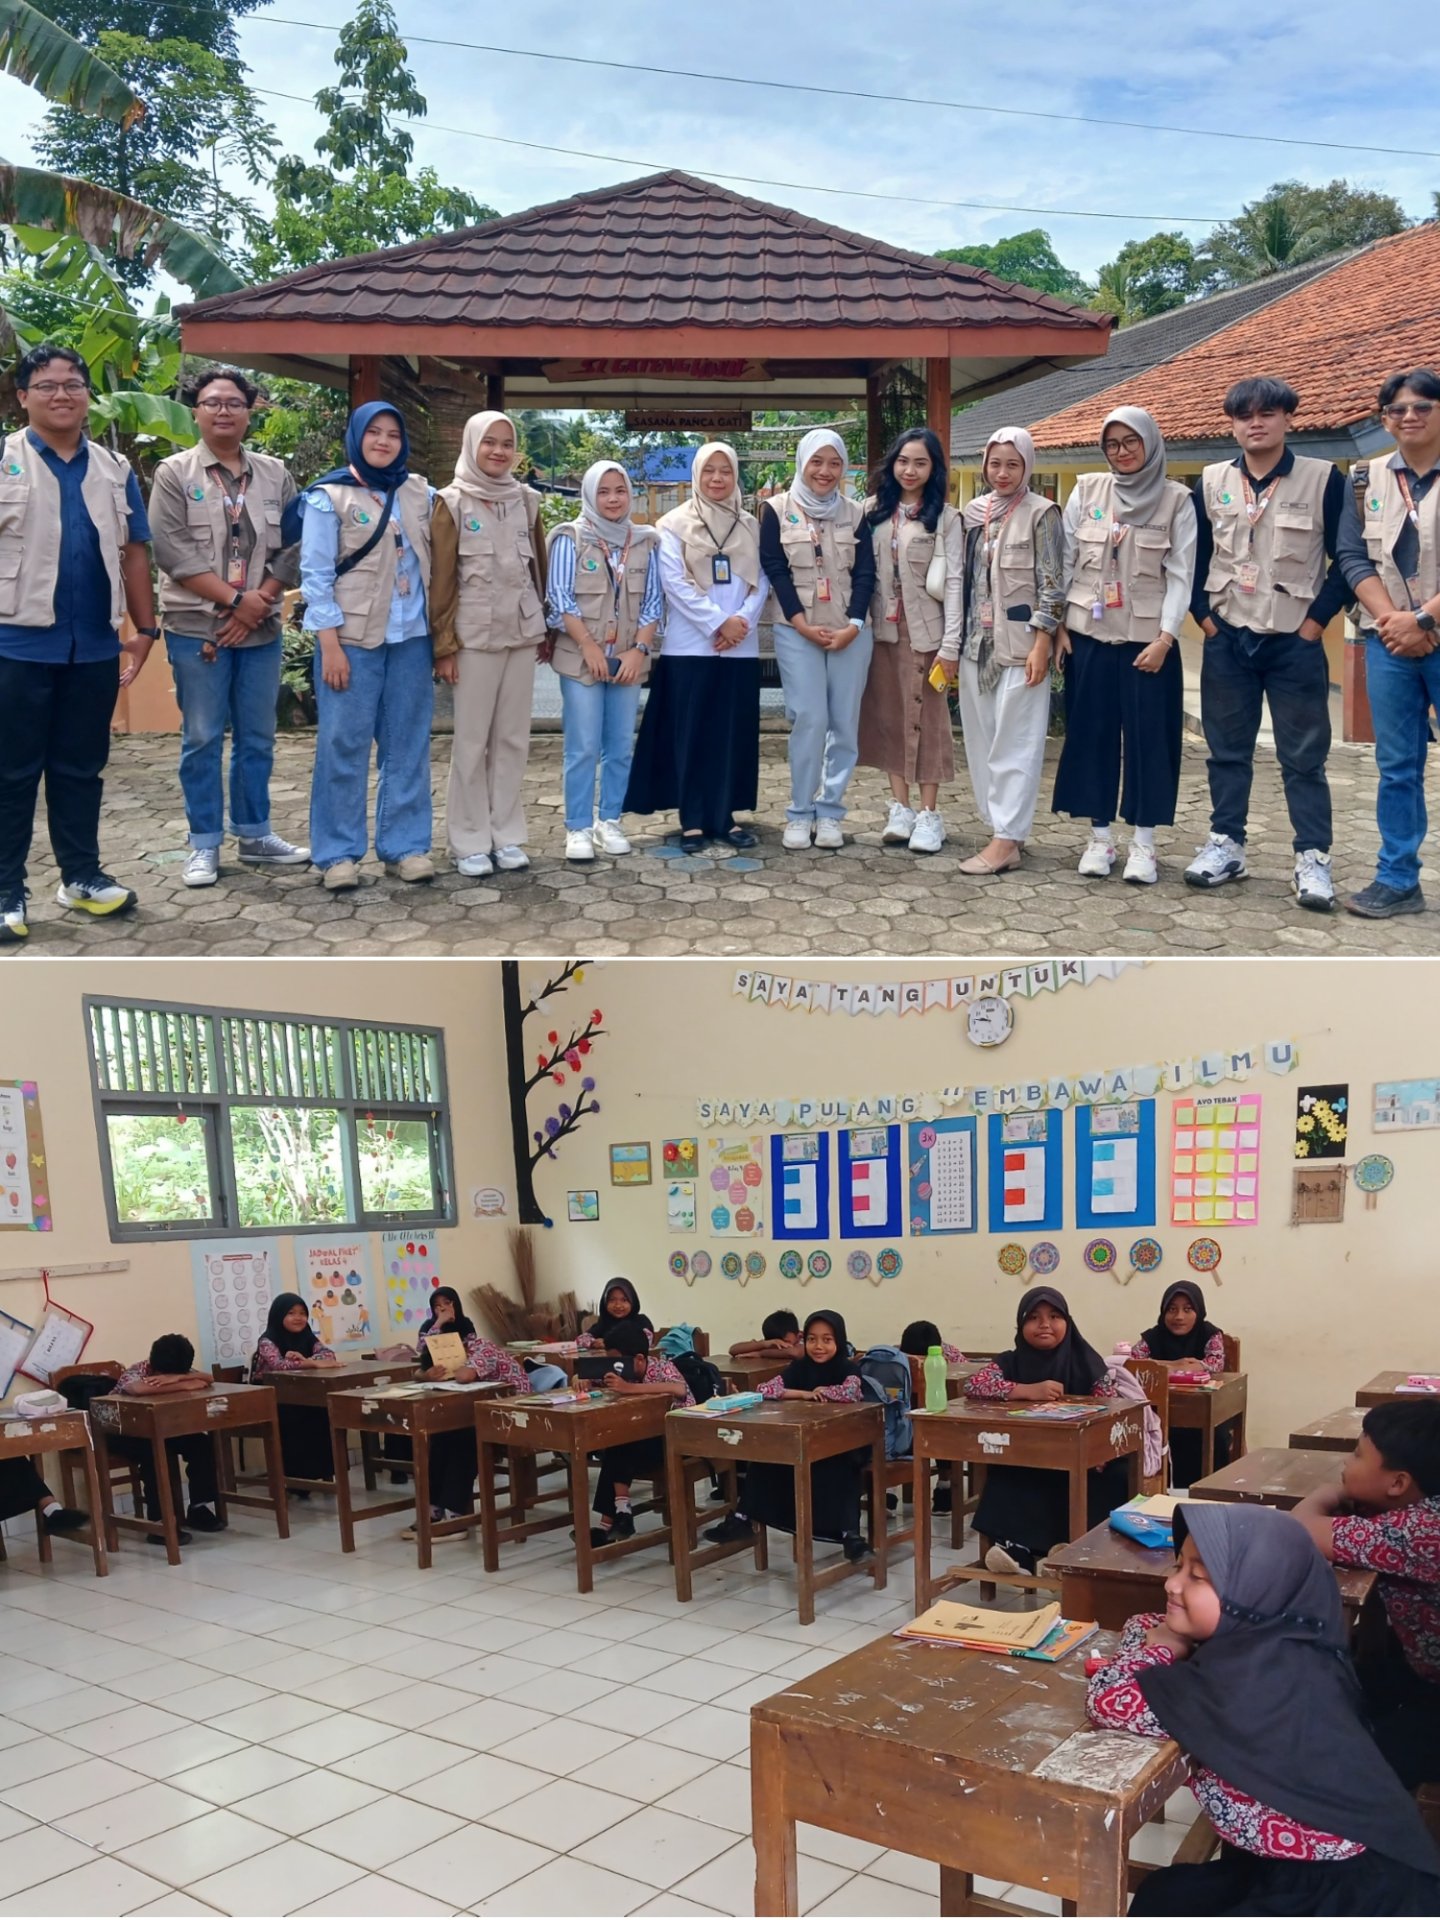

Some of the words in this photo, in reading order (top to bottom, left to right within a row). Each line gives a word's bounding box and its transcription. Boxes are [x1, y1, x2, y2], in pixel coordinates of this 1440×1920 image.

[633, 416, 676, 426] SASANA
[678, 416, 714, 426] PANCA
[717, 416, 742, 426] GATI
[737, 974, 808, 999] SAYA
[836, 988, 920, 1003] TANG
[955, 961, 1078, 996] UNTUK
[700, 1103, 770, 1119] SAYA
[799, 1097, 915, 1119] PULANG
[1174, 1044, 1292, 1083] ILMU
[1197, 1098, 1213, 1106] AYO
[1213, 1096, 1238, 1105] TEBAK
[922, 1132, 933, 1143] 3x
